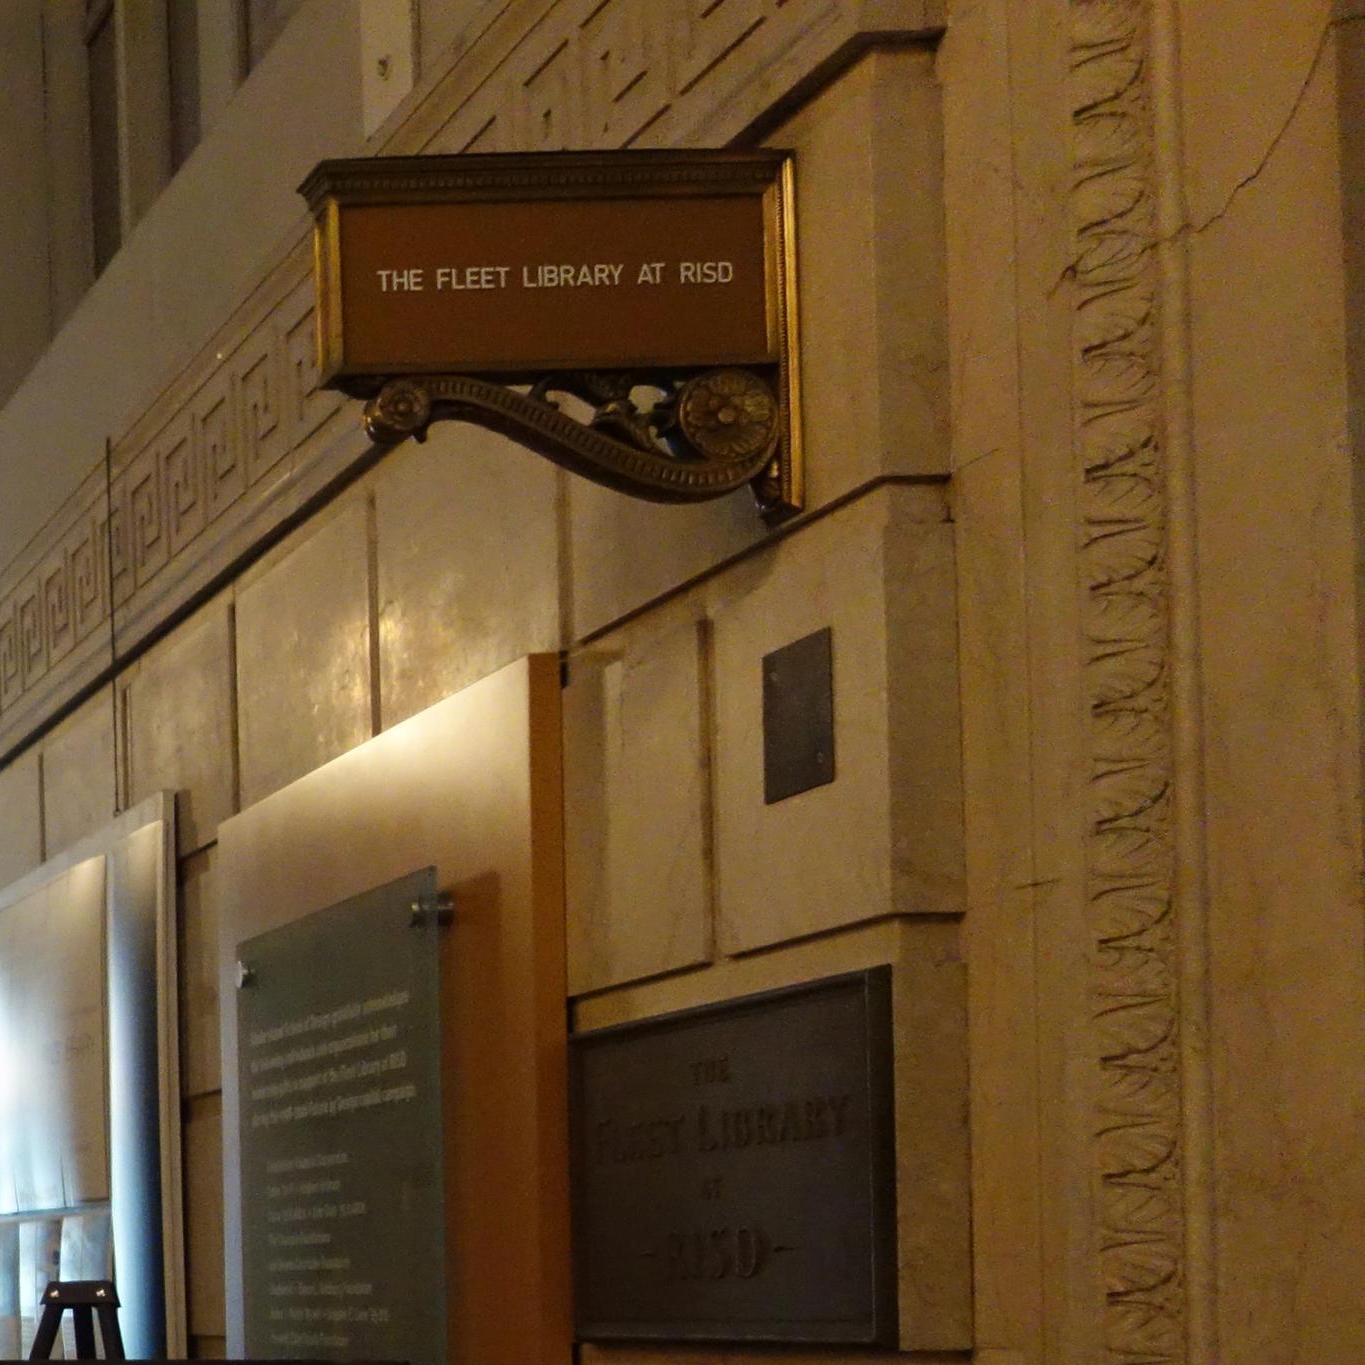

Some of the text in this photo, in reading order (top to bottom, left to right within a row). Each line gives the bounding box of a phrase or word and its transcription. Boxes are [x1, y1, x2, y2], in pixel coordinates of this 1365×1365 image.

[377, 261, 733, 292] THE FLEET LIBRARY AT RISD
[690, 1057, 730, 1085] THE
[695, 1094, 852, 1151] LIBRARY
